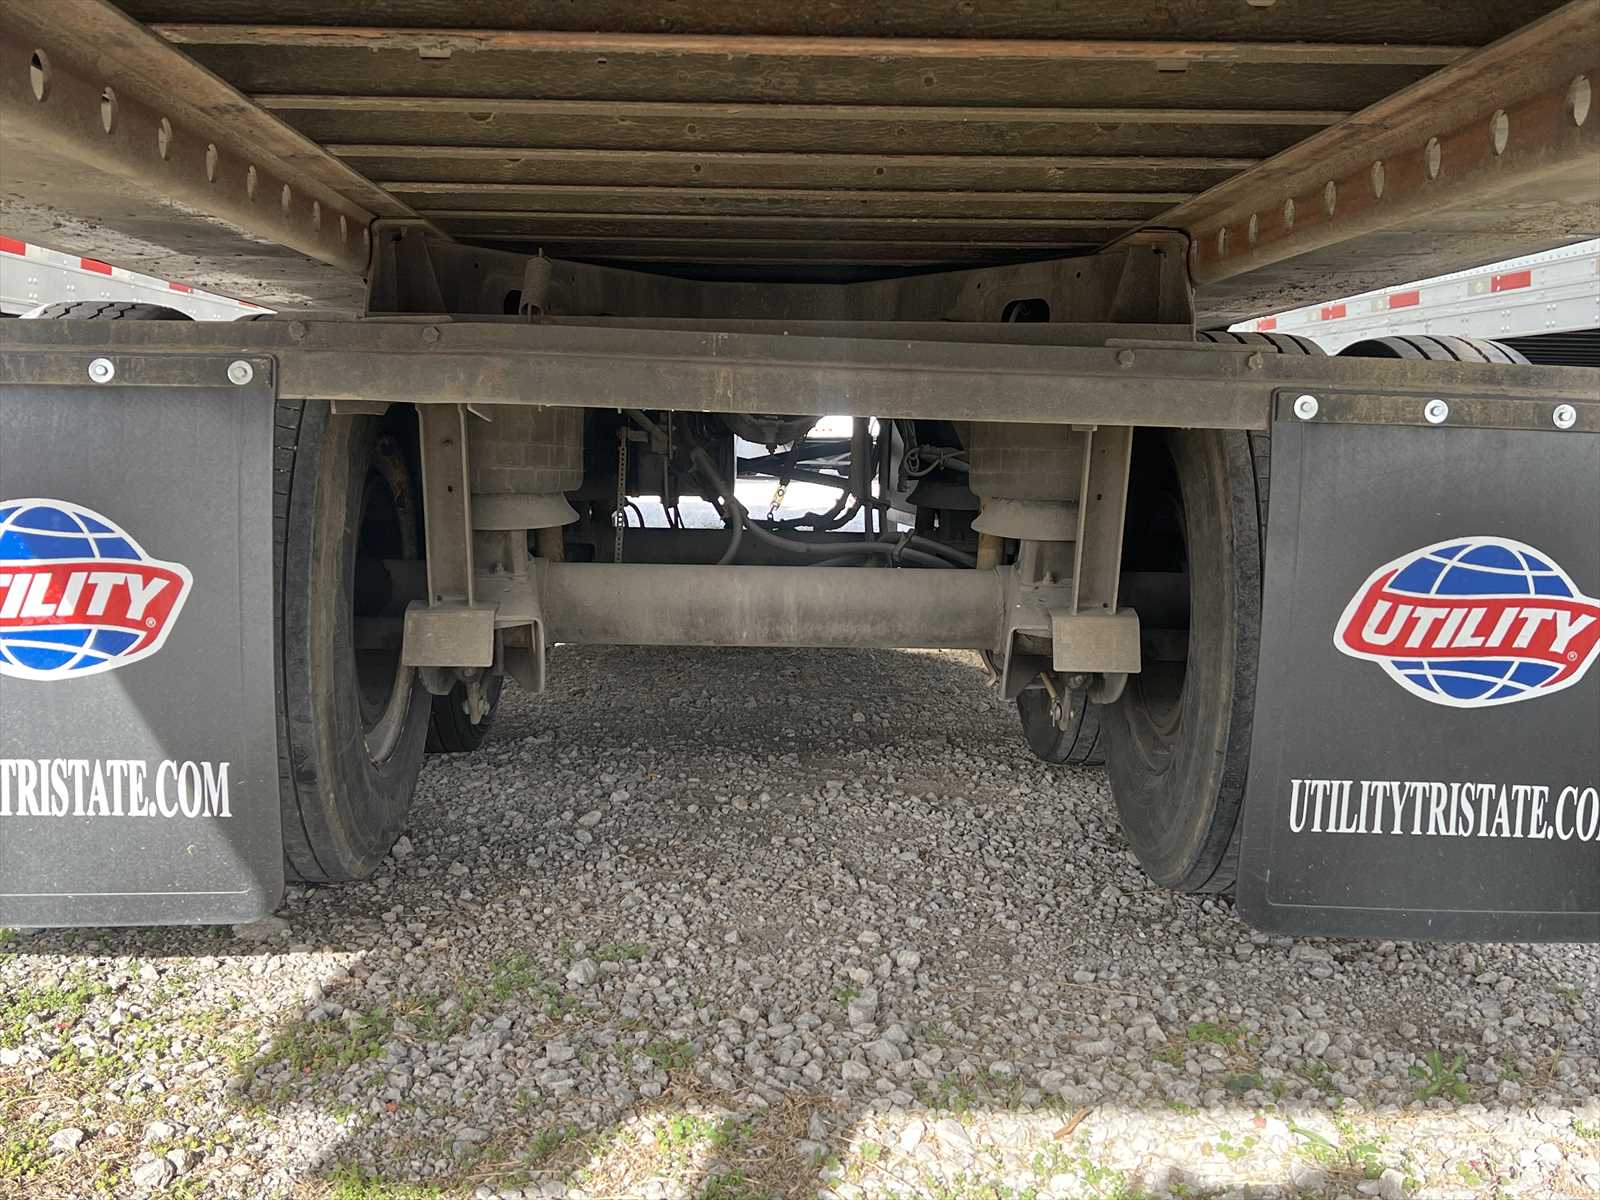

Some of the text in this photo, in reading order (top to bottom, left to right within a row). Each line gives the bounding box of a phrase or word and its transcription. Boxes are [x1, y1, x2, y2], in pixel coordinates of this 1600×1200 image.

[0, 571, 170, 621] ILITY
[1361, 599, 1597, 654] UTILITY
[0, 758, 232, 818] TRISTATE.COM
[1289, 779, 1600, 842] UTILITYTRISTATE.CO
